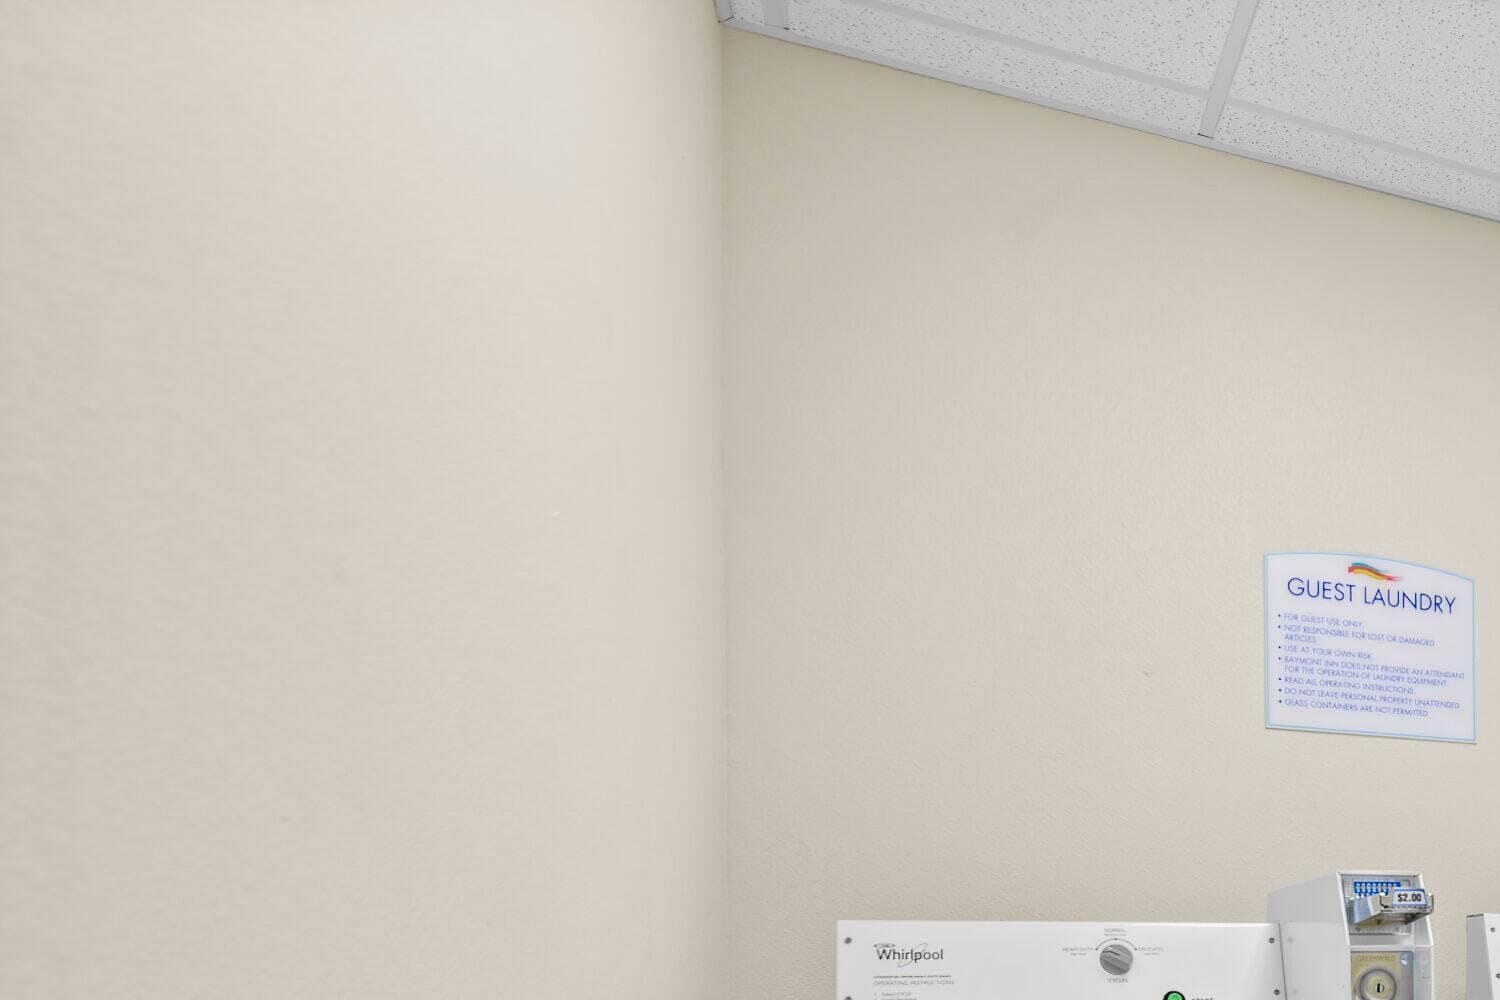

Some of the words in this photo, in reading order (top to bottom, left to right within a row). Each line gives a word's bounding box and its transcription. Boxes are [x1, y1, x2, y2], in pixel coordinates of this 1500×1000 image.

[1287, 577, 1356, 602] GUEST
[1364, 585, 1456, 614] LAUNDRY
[1284, 613, 1299, 621] FOR
[1300, 614, 1325, 624] GUEST
[1326, 617, 1340, 626] USE
[1284, 624, 1301, 632] NOT
[1303, 626, 1349, 637] RESPONSIBLE
[1351, 631, 1366, 639] FOR
[1367, 633, 1385, 642] LOST
[1386, 635, 1397, 643] OR
[1398, 636, 1436, 647] DAMAGED
[1284, 644, 1297, 653] USE
[1312, 647, 1333, 656] YOUR
[1334, 649, 1356, 658] OWN
[1285, 655, 1323, 665] BAYMONT
[1325, 659, 1339, 668] INN
[1341, 660, 1361, 670] DOES
[1363, 663, 1379, 672] NOT
[1381, 664, 1409, 675] PROVIDE
[1412, 668, 1424, 677] AN
[1425, 670, 1465, 680] ATTENDANT
[1285, 665, 1299, 673] FOR
[1302, 666, 1314, 675] THE
[1317, 668, 1359, 679] OPERATION
[1361, 671, 1371, 679] OF
[1373, 673, 1405, 683] LAUNDRY
[1285, 676, 1304, 685] READ
[1306, 678, 1318, 686] ALL
[1319, 679, 1361, 690] OPERATING
[1285, 687, 1297, 695] DO
[1299, 688, 1316, 697] NOT
[1318, 690, 1339, 699] LEAVE
[1341, 692, 1378, 702] PERSONAL
[1380, 695, 1413, 705] PROPERTY
[1285, 698, 1309, 707] GLASS
[1310, 700, 1358, 711] CONTAINERS
[1360, 705, 1374, 713] ARE
[1397, 894, 1422, 903] $2.00
[876, 948, 944, 964] Whirlpool
